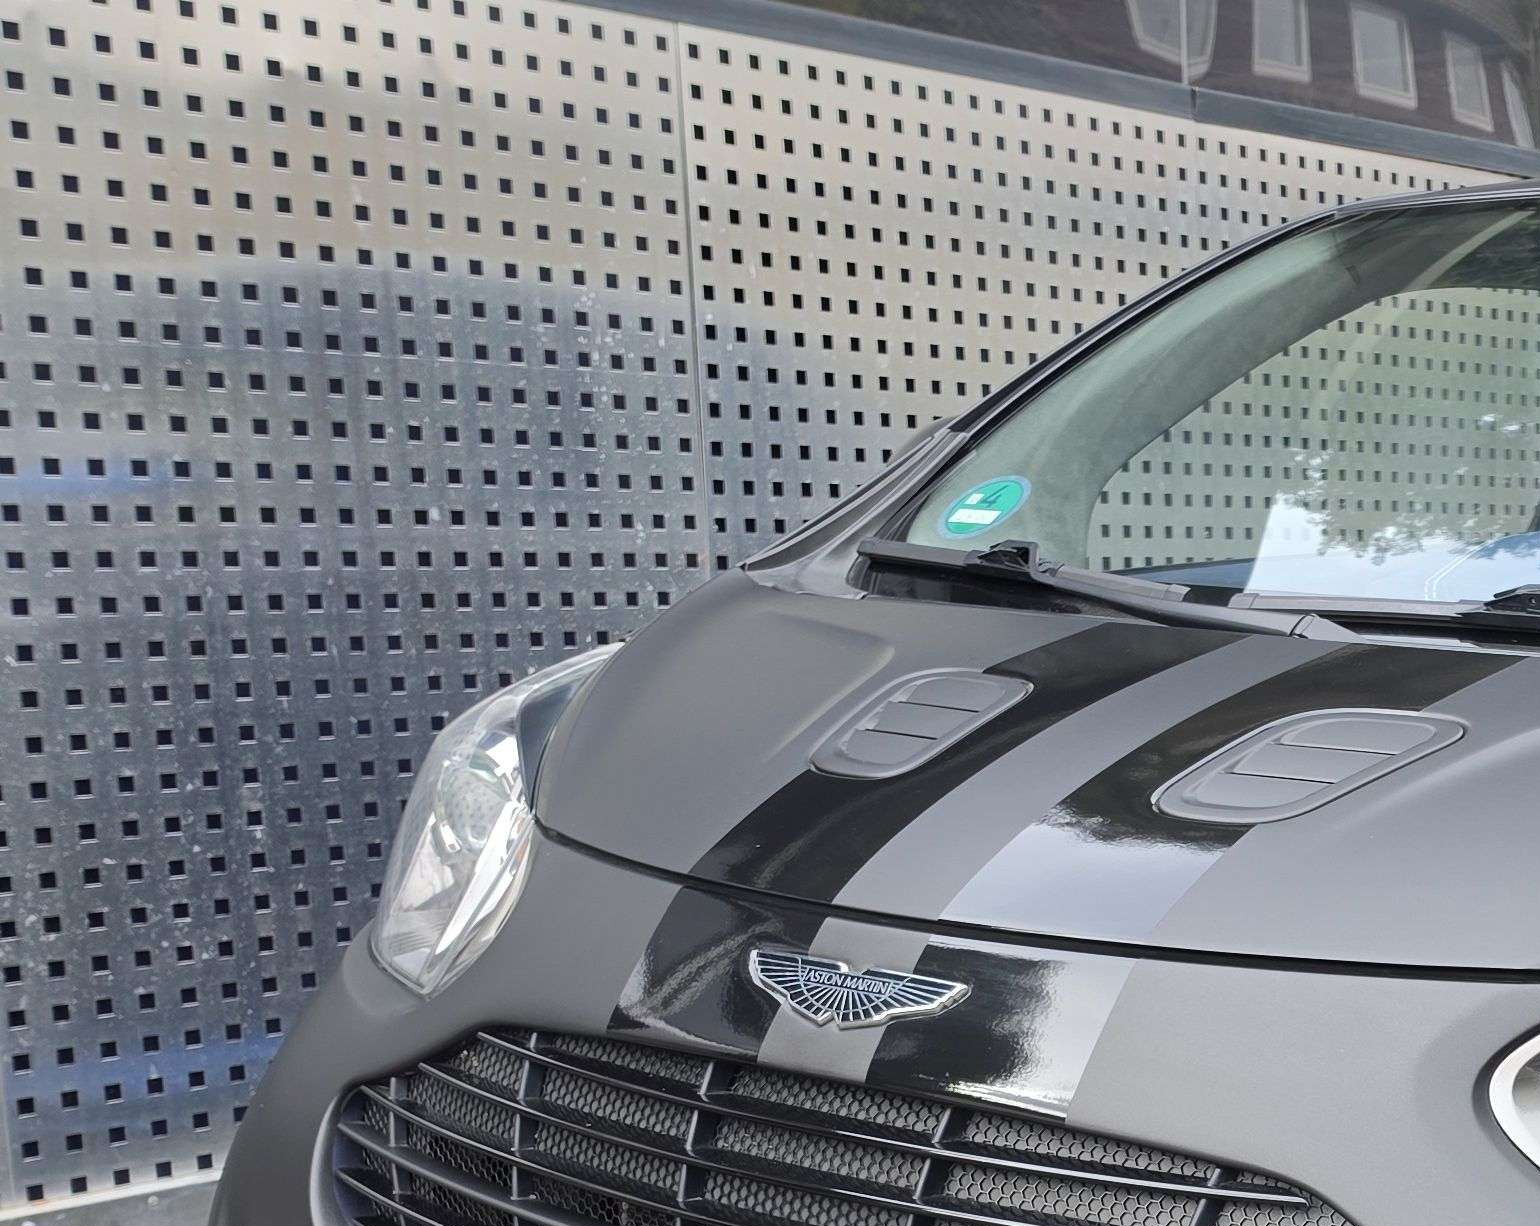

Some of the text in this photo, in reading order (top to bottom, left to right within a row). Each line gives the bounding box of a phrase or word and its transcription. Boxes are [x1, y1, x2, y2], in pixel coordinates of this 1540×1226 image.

[979, 484, 1009, 508] 4
[805, 969, 888, 994] ASTON MARTIN
